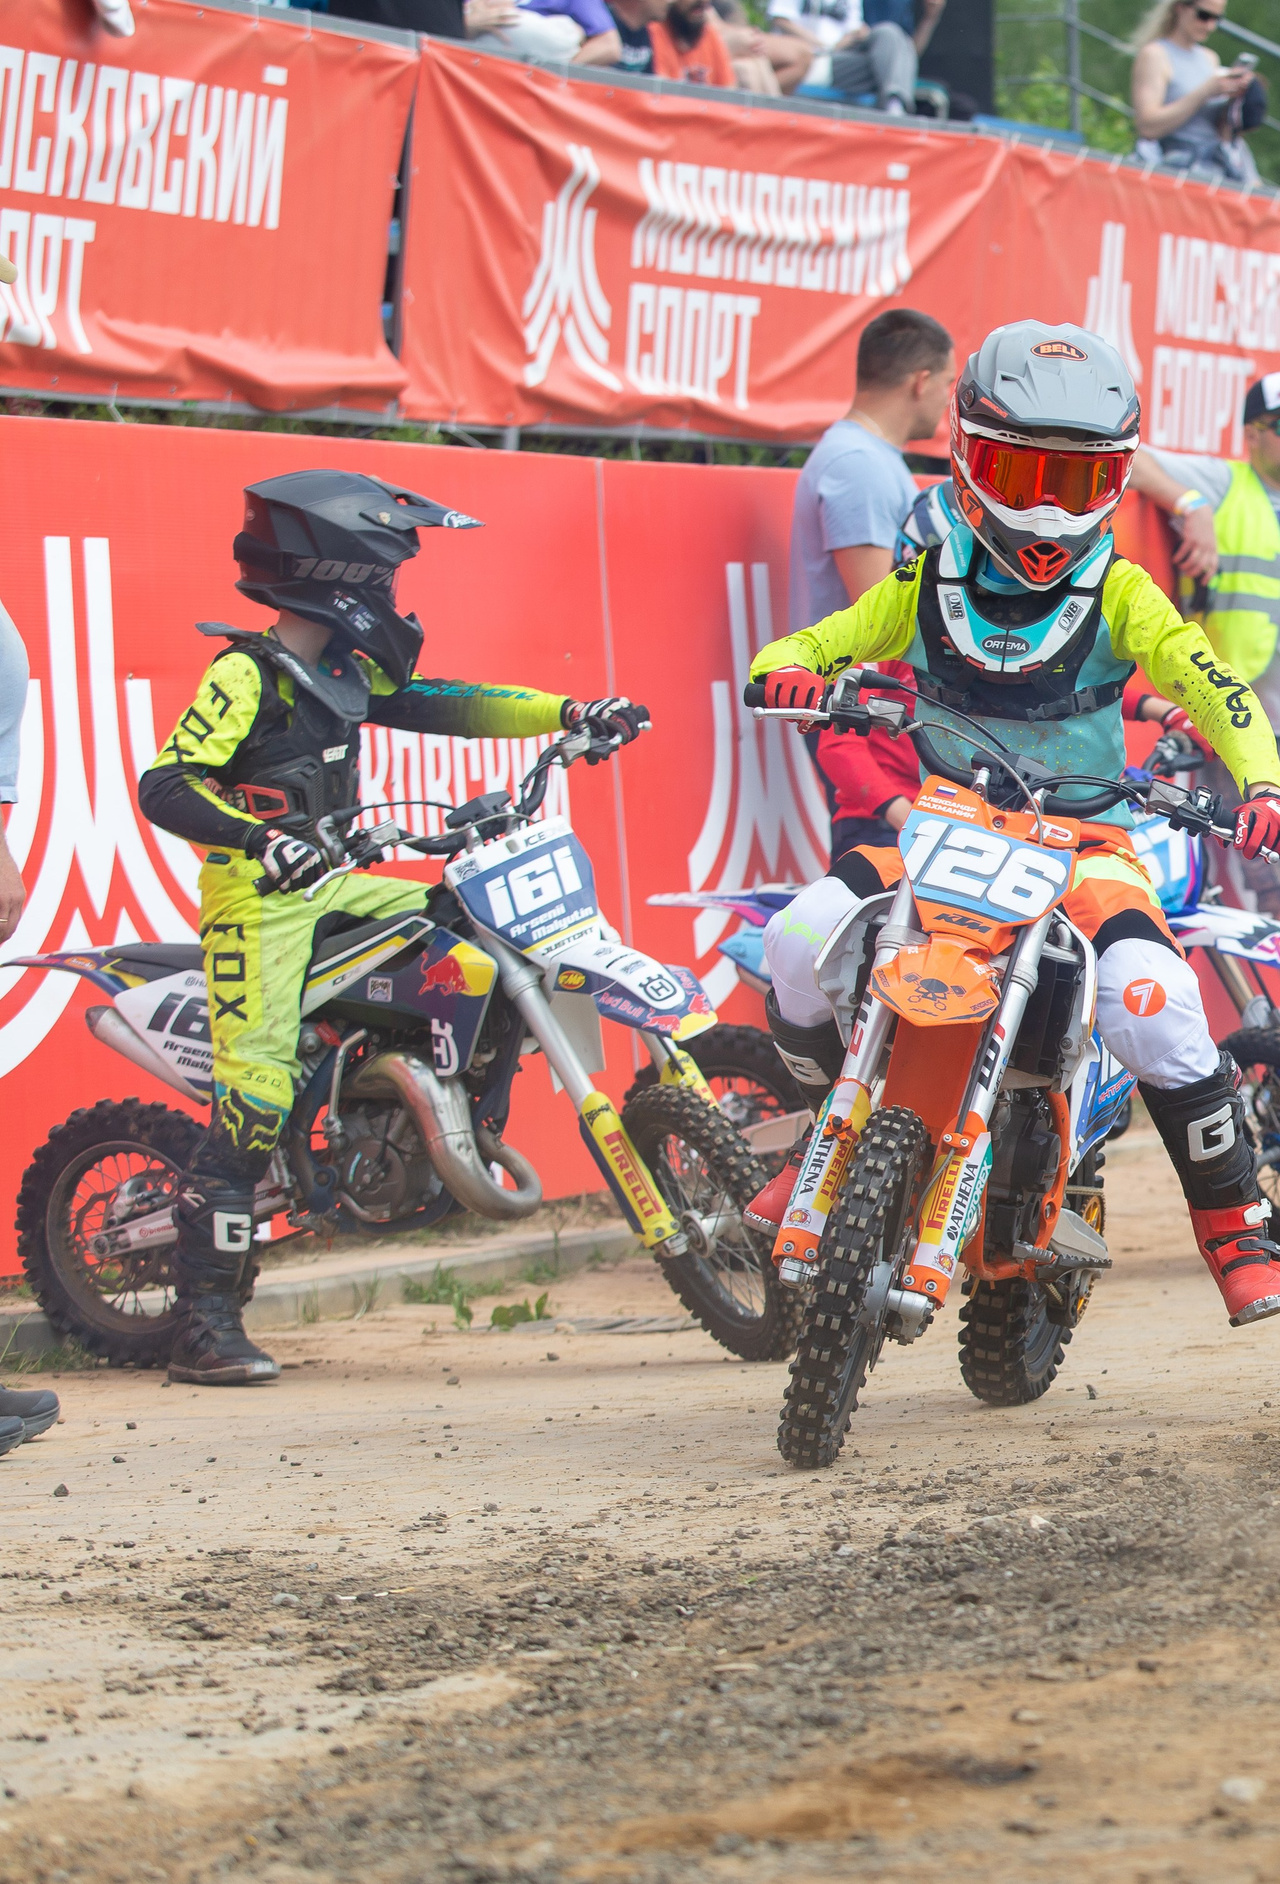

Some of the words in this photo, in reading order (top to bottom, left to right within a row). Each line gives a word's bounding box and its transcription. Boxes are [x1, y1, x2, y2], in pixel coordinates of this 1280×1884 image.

[0, 45, 288, 230] ОСКОВСКИЙ
[630, 157, 912, 297] МОСКОВСКИЙ
[0, 207, 96, 354] ОРТ
[625, 282, 761, 410] СПОРТ
[1040, 343, 1079, 358] BELL
[1150, 345, 1256, 458] СПОРТ
[293, 557, 394, 587] 100%
[984, 639, 1027, 651] ORTEMA
[164, 681, 234, 764] FOX
[346, 726, 571, 862] КОВСКИЙ
[917, 801, 976, 820] РАХМАНИН
[919, 795, 977, 813] АЛЕКСАНДР
[484, 845, 583, 930] 161
[903, 819, 1068, 918] 126
[510, 903, 567, 939] Arsenii
[531, 905, 594, 943] Malyutin
[933, 912, 993, 935] KTM
[213, 923, 248, 1022] FOX
[147, 992, 212, 1044] 16
[599, 991, 622, 1009] Red
[621, 997, 644, 1019] Bull
[163, 1040, 214, 1060] Arsen
[176, 1056, 214, 1073] Maly
[604, 1130, 662, 1219] PIRELLI
[926, 1160, 961, 1230] PIRELLI
[951, 1163, 979, 1230] ATHENA
[149, 1223, 175, 1235] bremb
